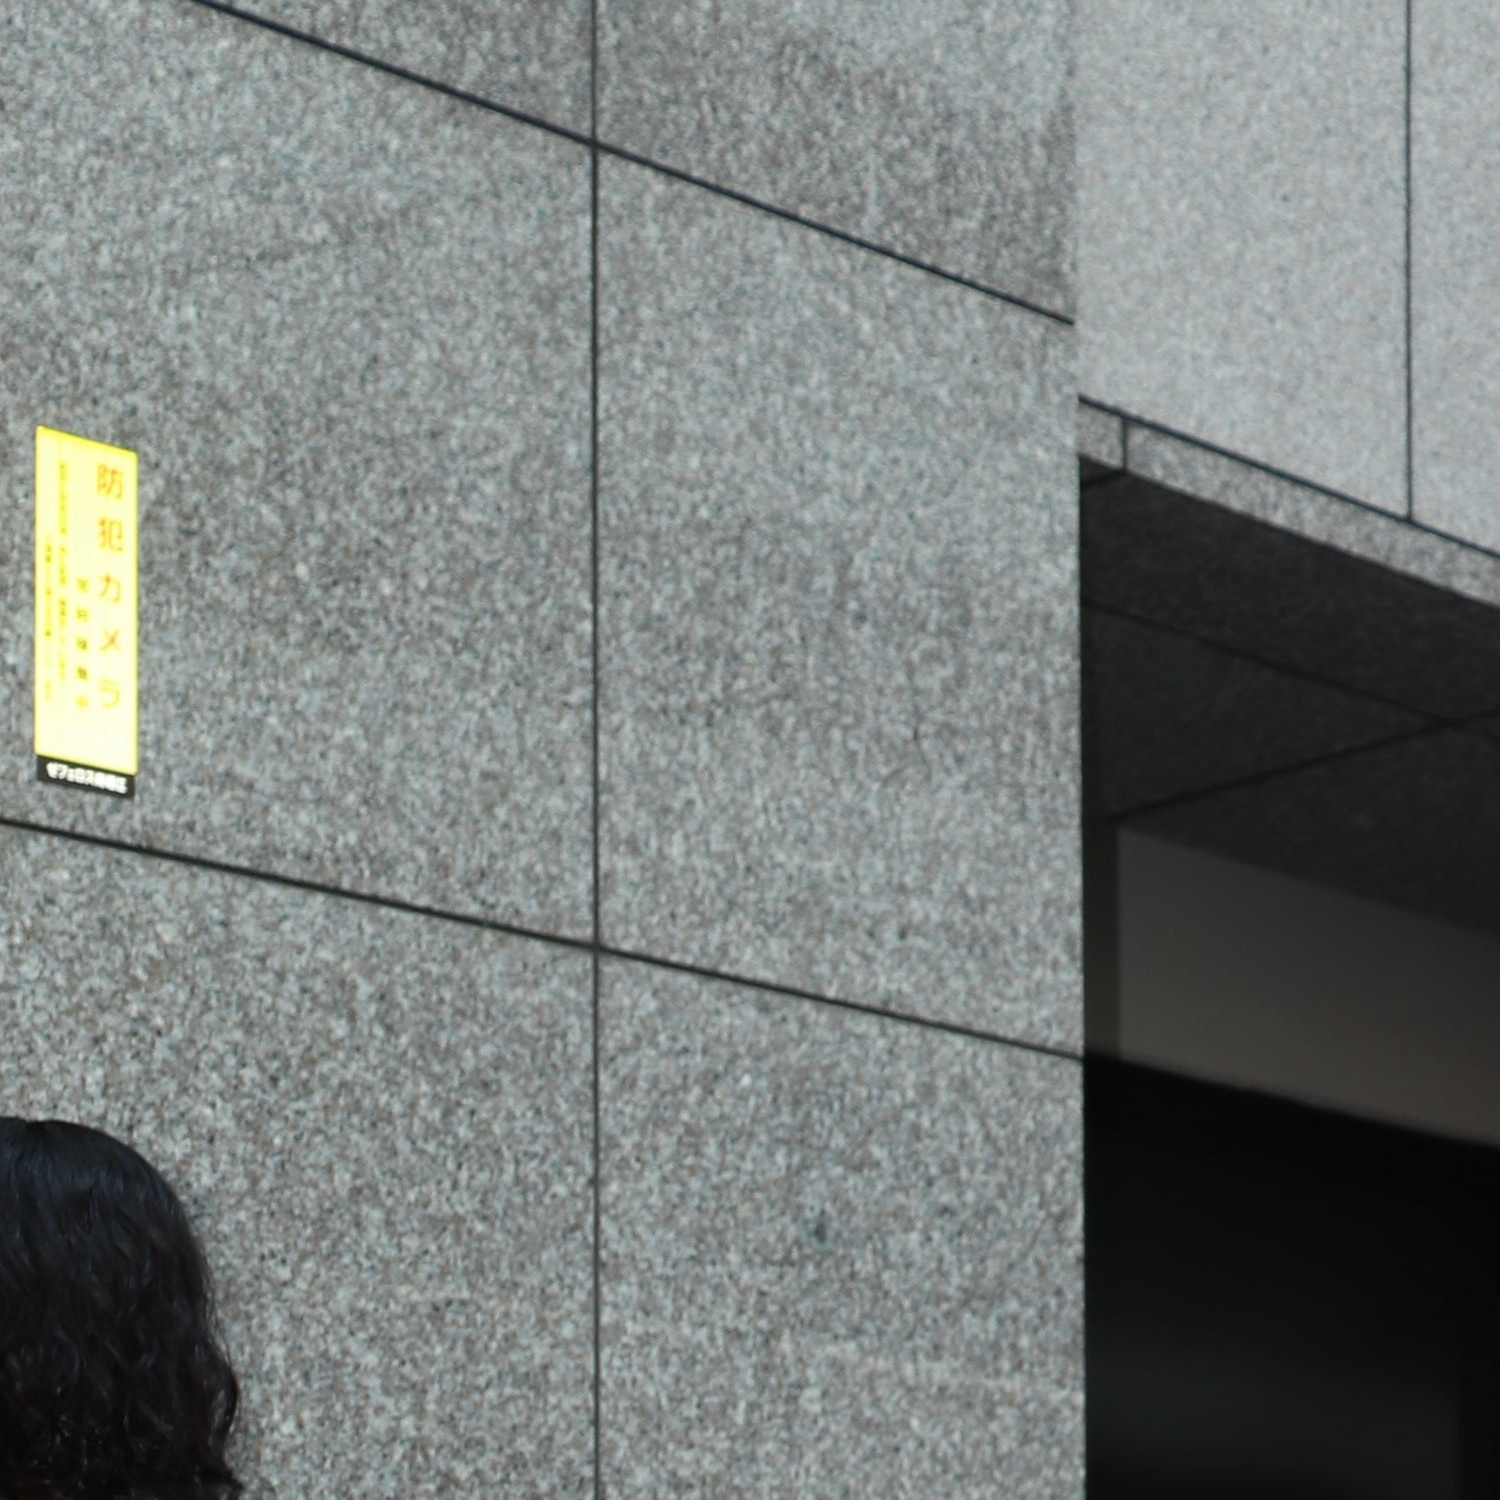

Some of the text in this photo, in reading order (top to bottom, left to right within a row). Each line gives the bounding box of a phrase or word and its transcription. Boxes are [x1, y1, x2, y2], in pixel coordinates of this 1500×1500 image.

[97, 463, 124, 708] 防犯カメラ
